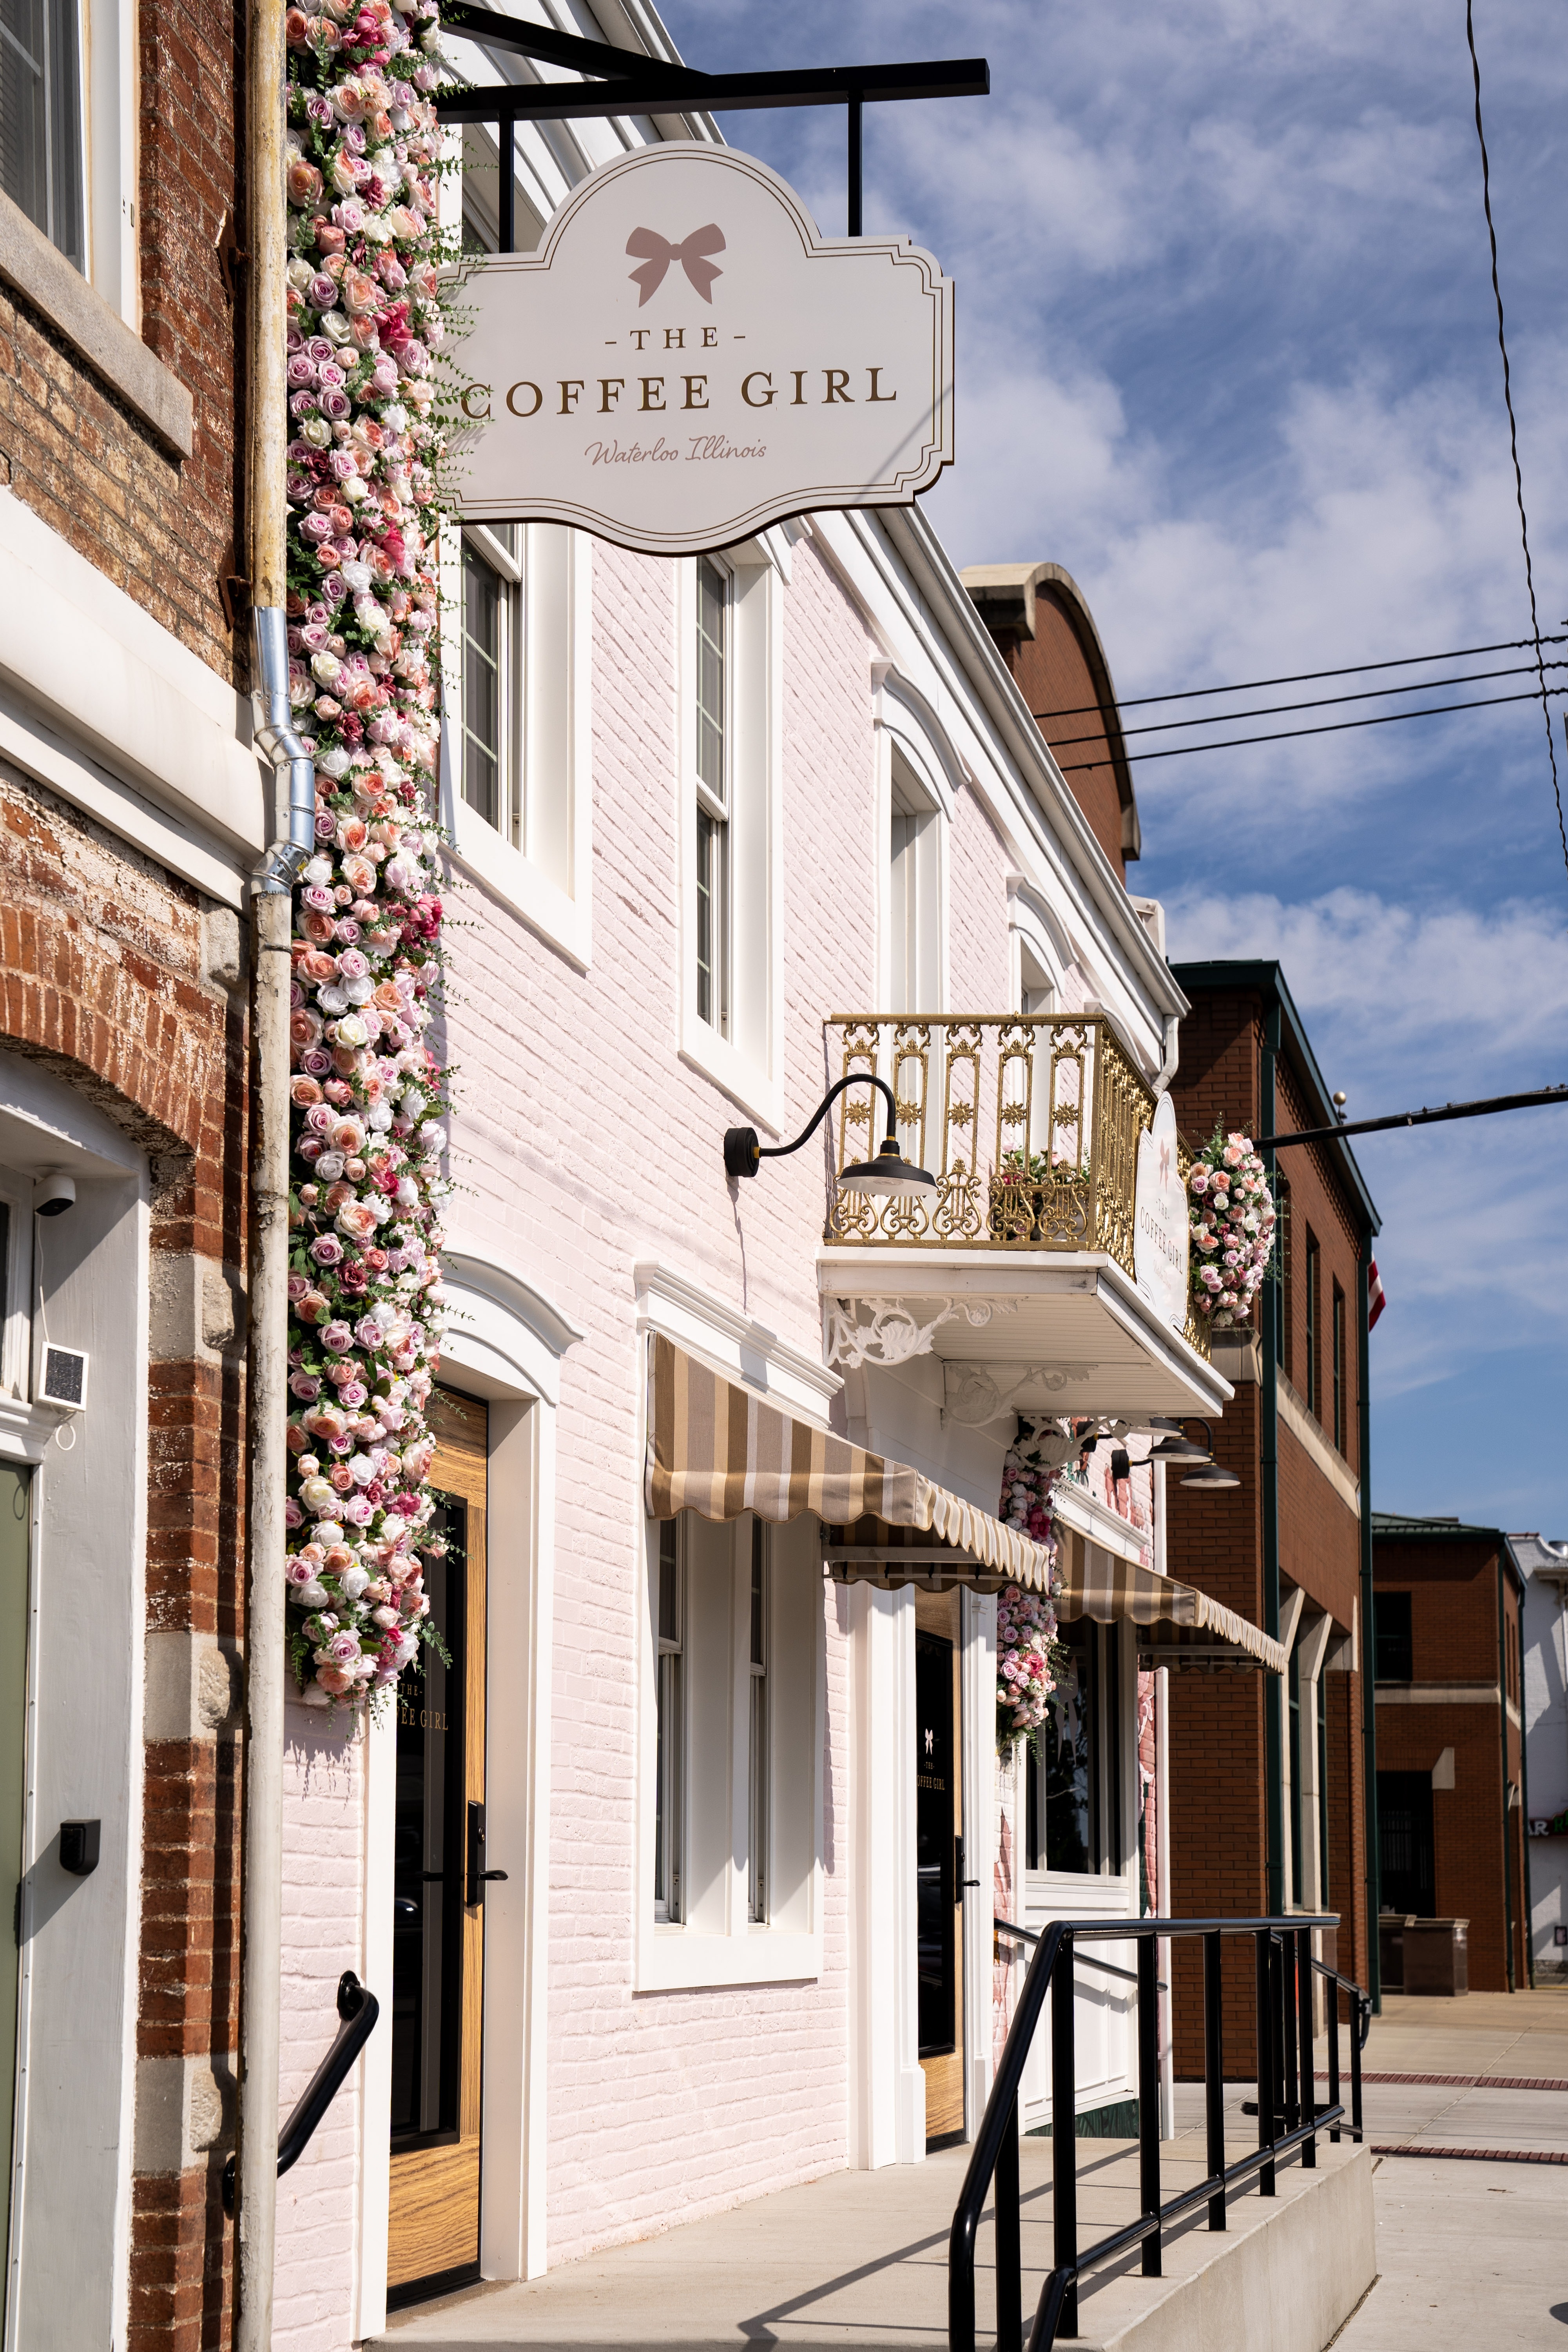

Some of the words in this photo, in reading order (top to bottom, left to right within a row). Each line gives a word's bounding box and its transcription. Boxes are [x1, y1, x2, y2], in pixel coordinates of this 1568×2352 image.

[461, 375, 709, 419] COFFEE
[741, 367, 897, 407] GIRL
[584, 437, 679, 466] Waterloo
[685, 435, 767, 461] Illinois
[1140, 1206, 1166, 1254] COFFEE
[1168, 1240, 1183, 1275] GIRL
[420, 1710, 448, 1730] GIRL
[933, 1777, 945, 1790] GIRL
